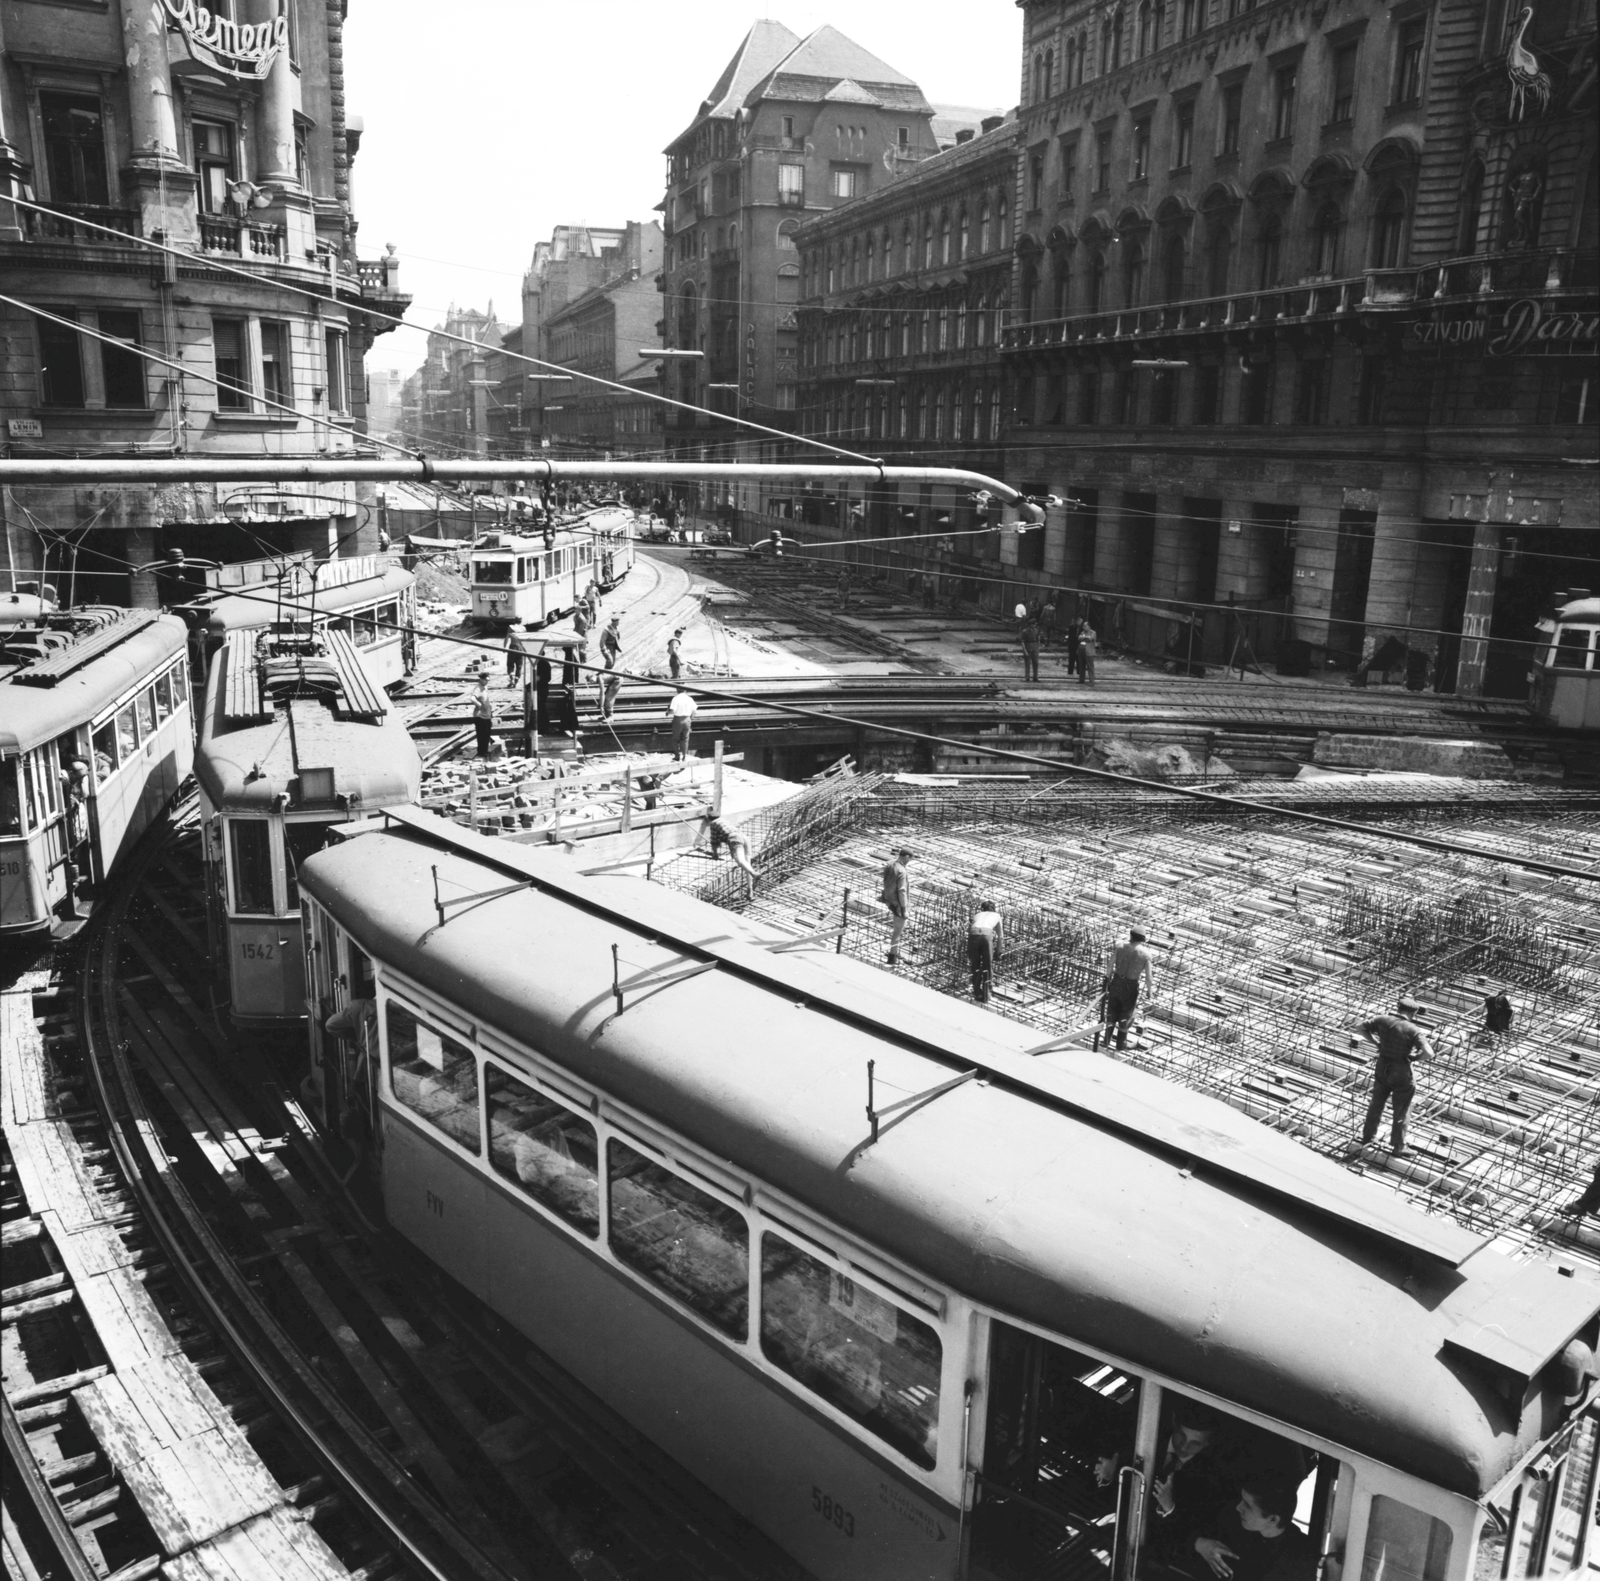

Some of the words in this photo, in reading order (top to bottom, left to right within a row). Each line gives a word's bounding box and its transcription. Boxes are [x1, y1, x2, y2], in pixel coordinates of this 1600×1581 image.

[241, 943, 274, 960] 1542
[427, 1190, 444, 1218] FVV
[836, 1273, 854, 1307] 19
[812, 1485, 855, 1538] 5893
